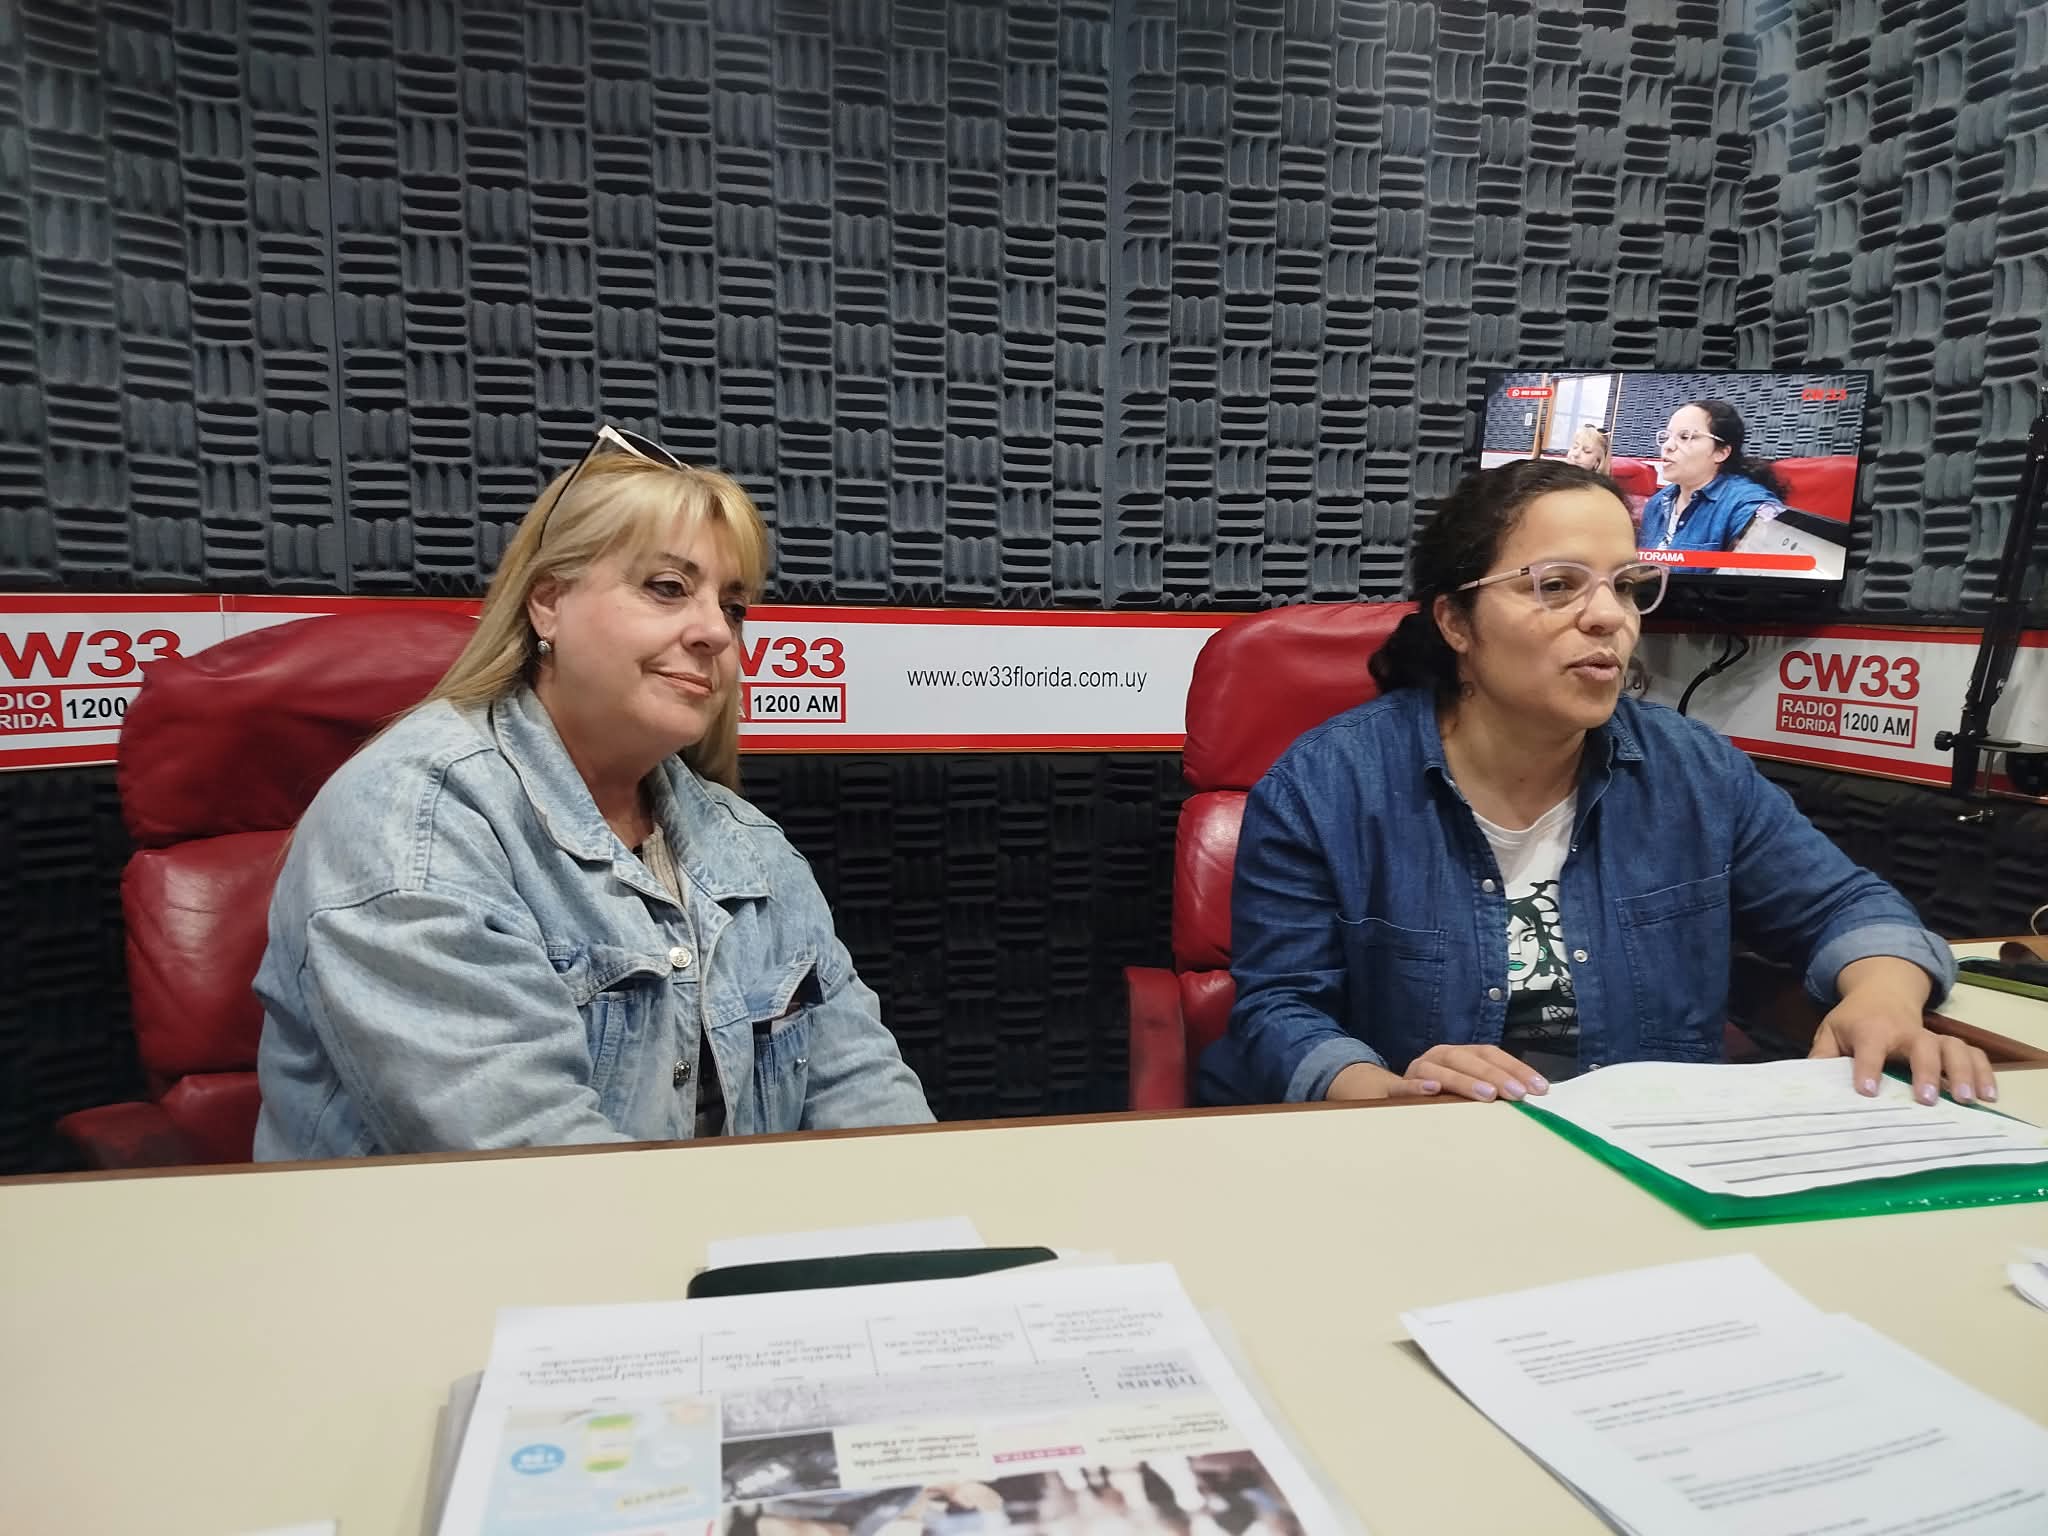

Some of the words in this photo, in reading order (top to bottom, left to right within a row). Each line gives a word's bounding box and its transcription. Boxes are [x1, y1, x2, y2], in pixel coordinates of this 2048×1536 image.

[1635, 551, 1685, 562] TORAMA
[906, 665, 1148, 693] www.cw33florida.com.uy
[1779, 650, 1921, 700] CW33
[66, 696, 128, 720] 1200
[753, 694, 800, 713] 1200
[806, 695, 838, 713] AM
[1782, 699, 1836, 717] RADIO
[1781, 715, 1837, 734] FLORIDA
[1843, 712, 1879, 733] 1200
[1883, 716, 1911, 737] AM
